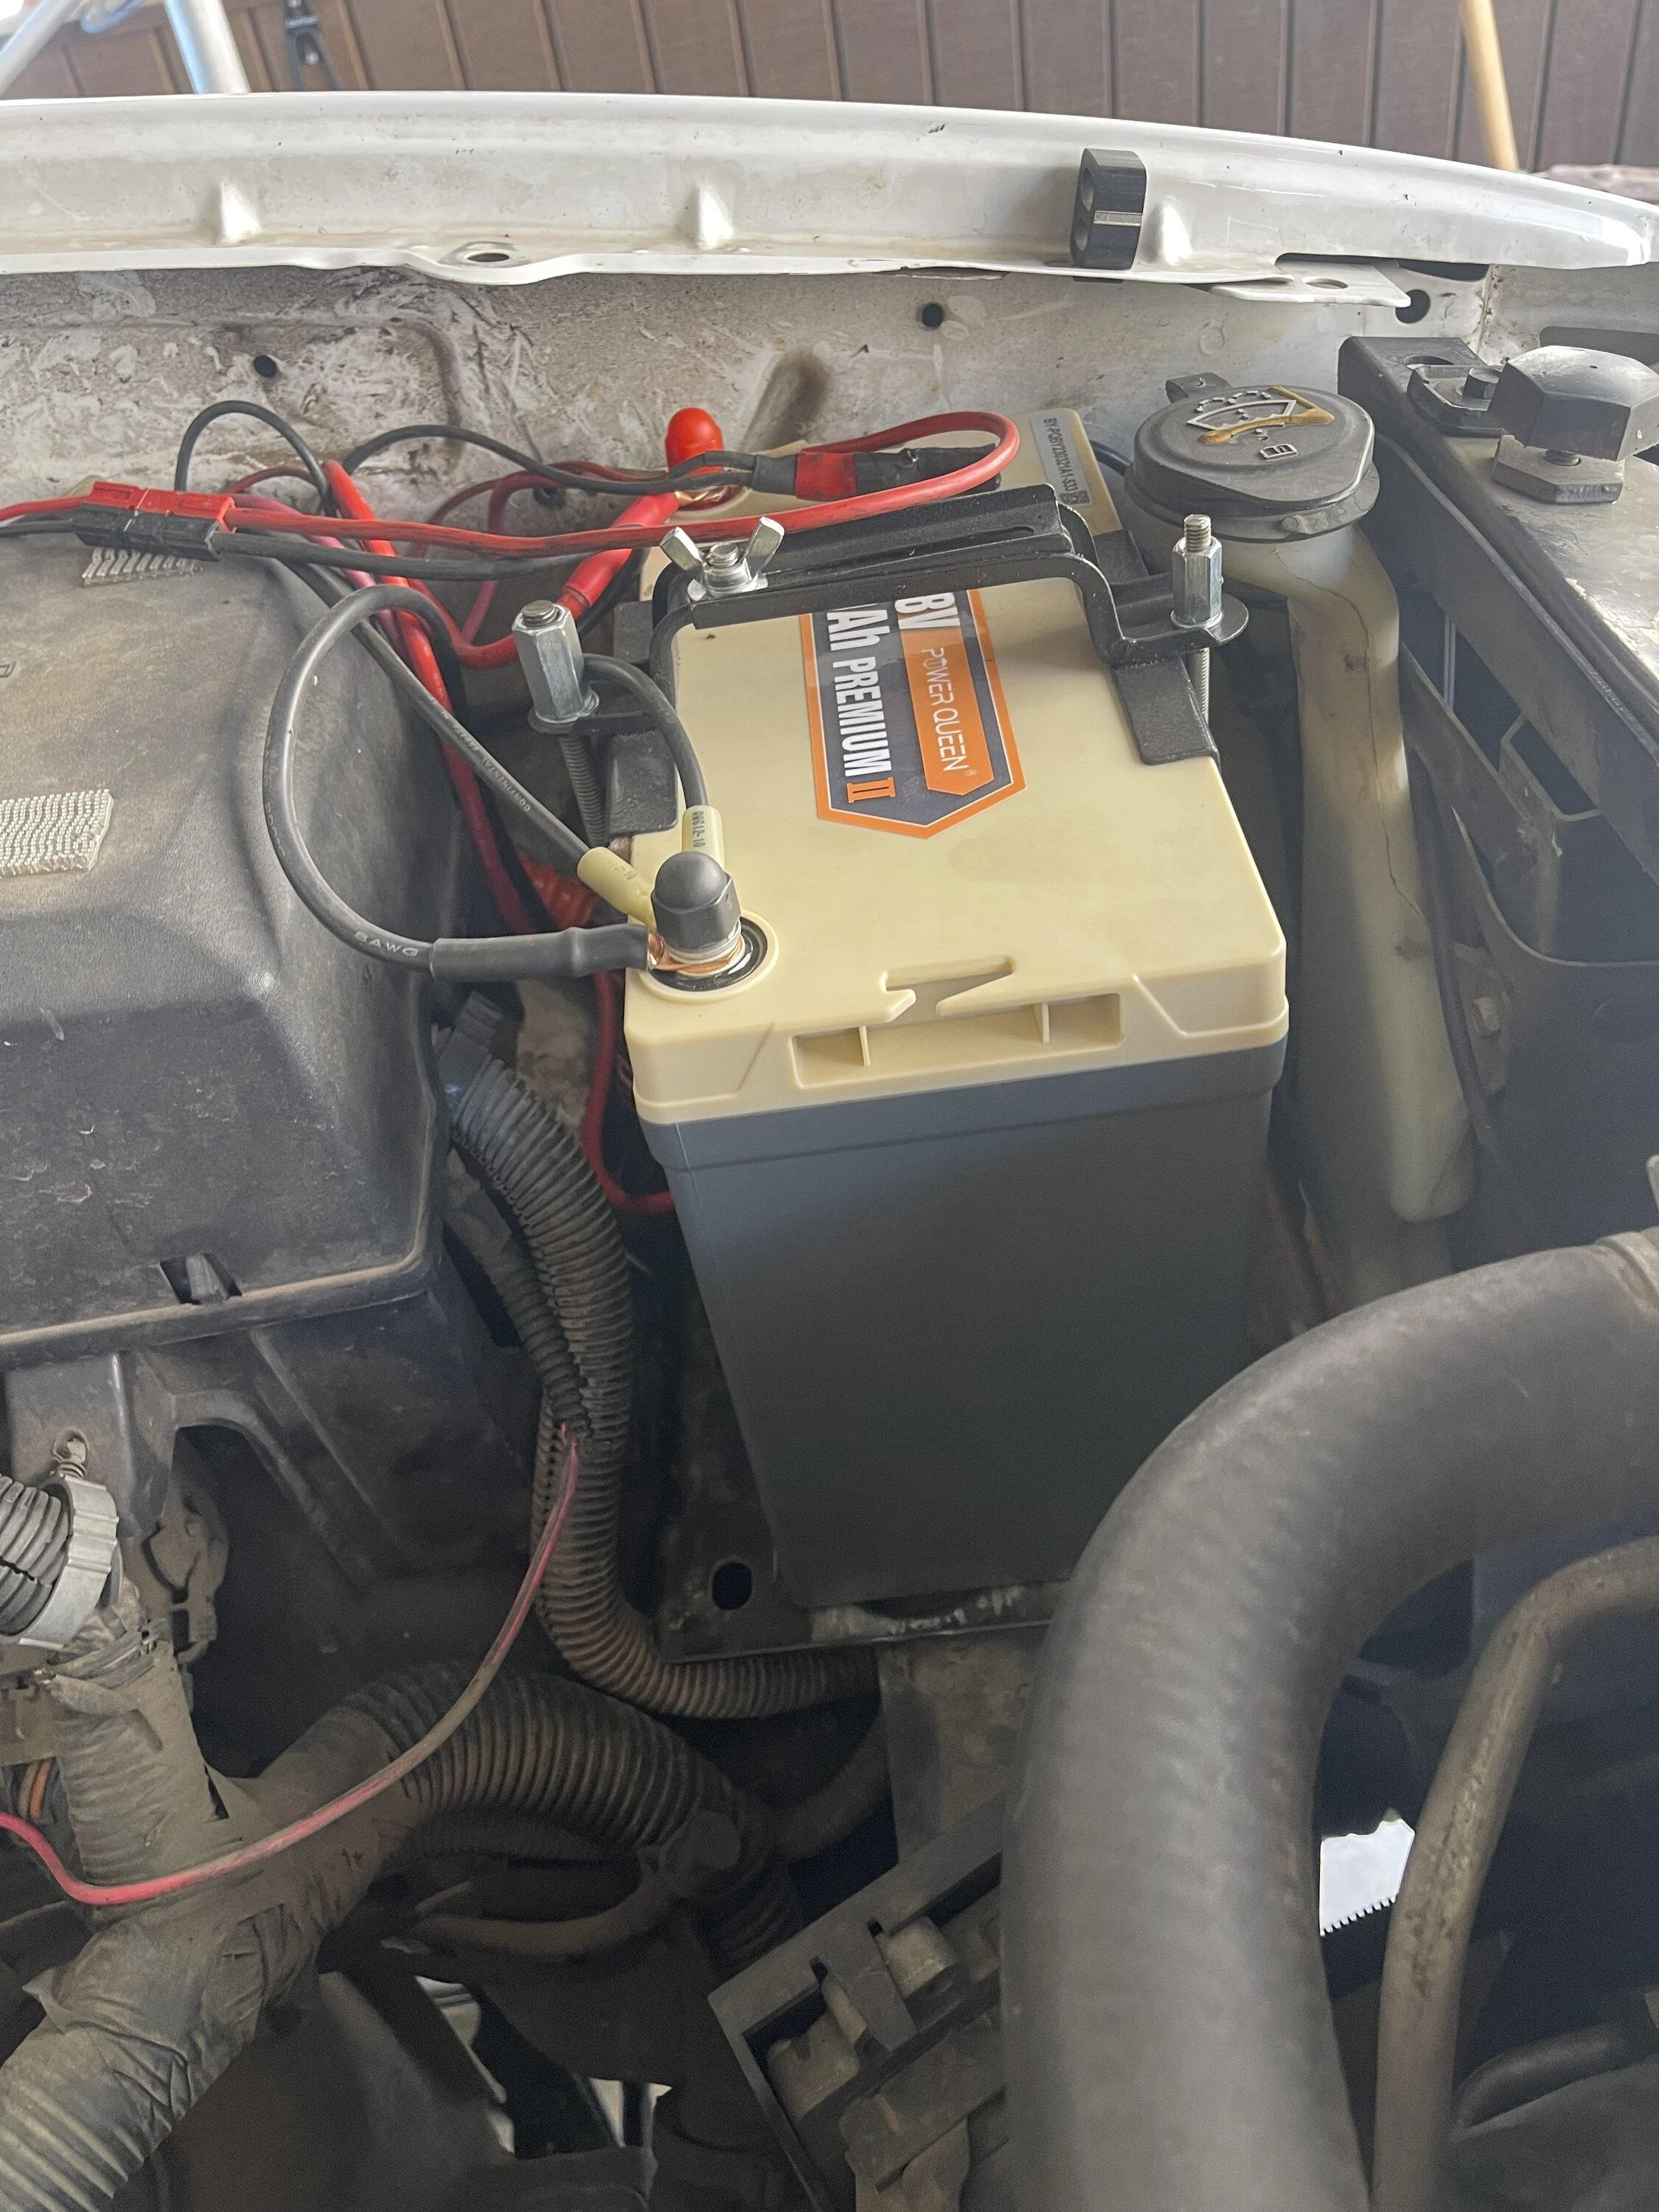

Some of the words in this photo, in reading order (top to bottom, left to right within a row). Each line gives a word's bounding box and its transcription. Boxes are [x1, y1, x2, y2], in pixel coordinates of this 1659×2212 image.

[827, 603, 890, 651] Ah
[922, 647, 954, 706] POWER
[832, 656, 892, 776] PREMIUM
[933, 707, 969, 772] QUEEN
